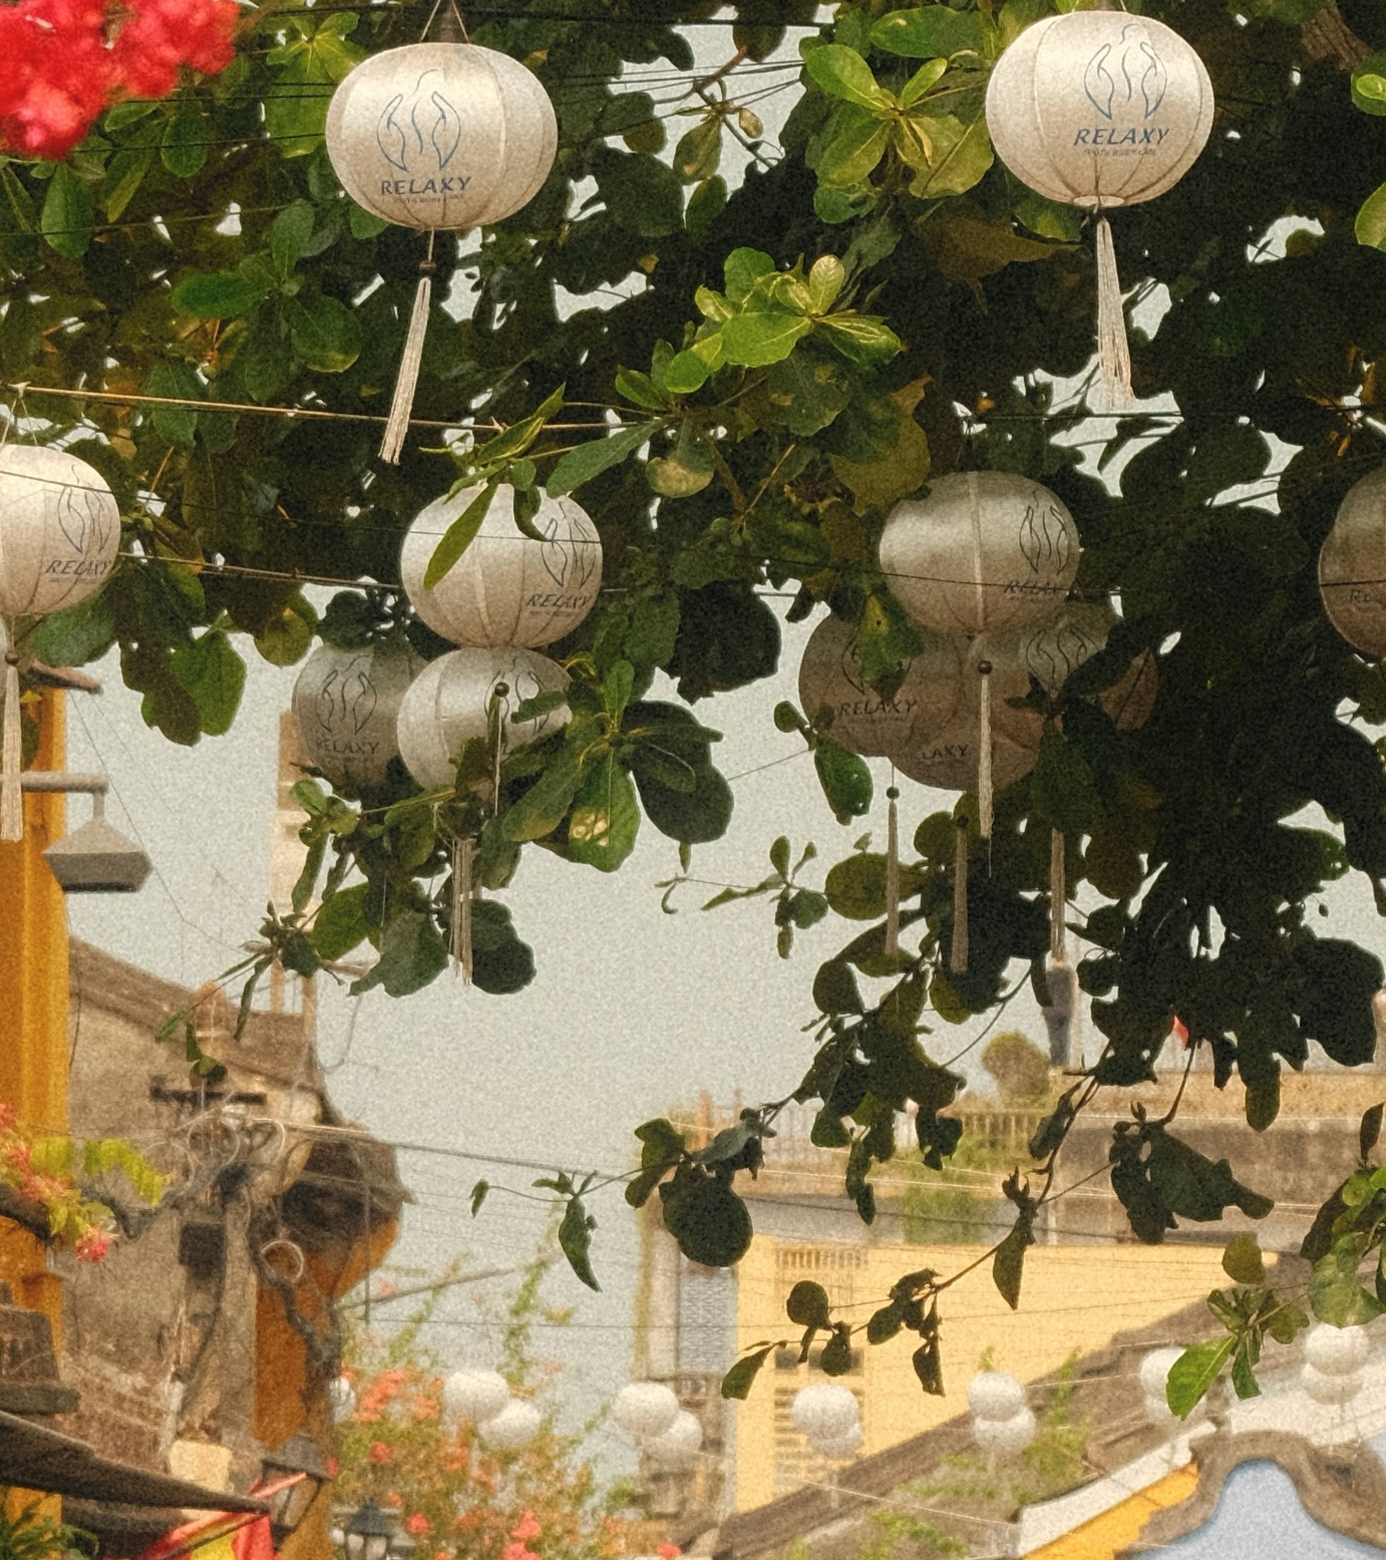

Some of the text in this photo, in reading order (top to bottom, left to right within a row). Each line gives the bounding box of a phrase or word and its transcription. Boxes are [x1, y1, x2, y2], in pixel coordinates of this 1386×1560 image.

[1073, 128, 1170, 146] RELAXY
[380, 176, 472, 196] RELAXY
[45, 560, 112, 576] RELAXY
[525, 593, 592, 609] RELAXY
[840, 700, 918, 717] RELAXY
